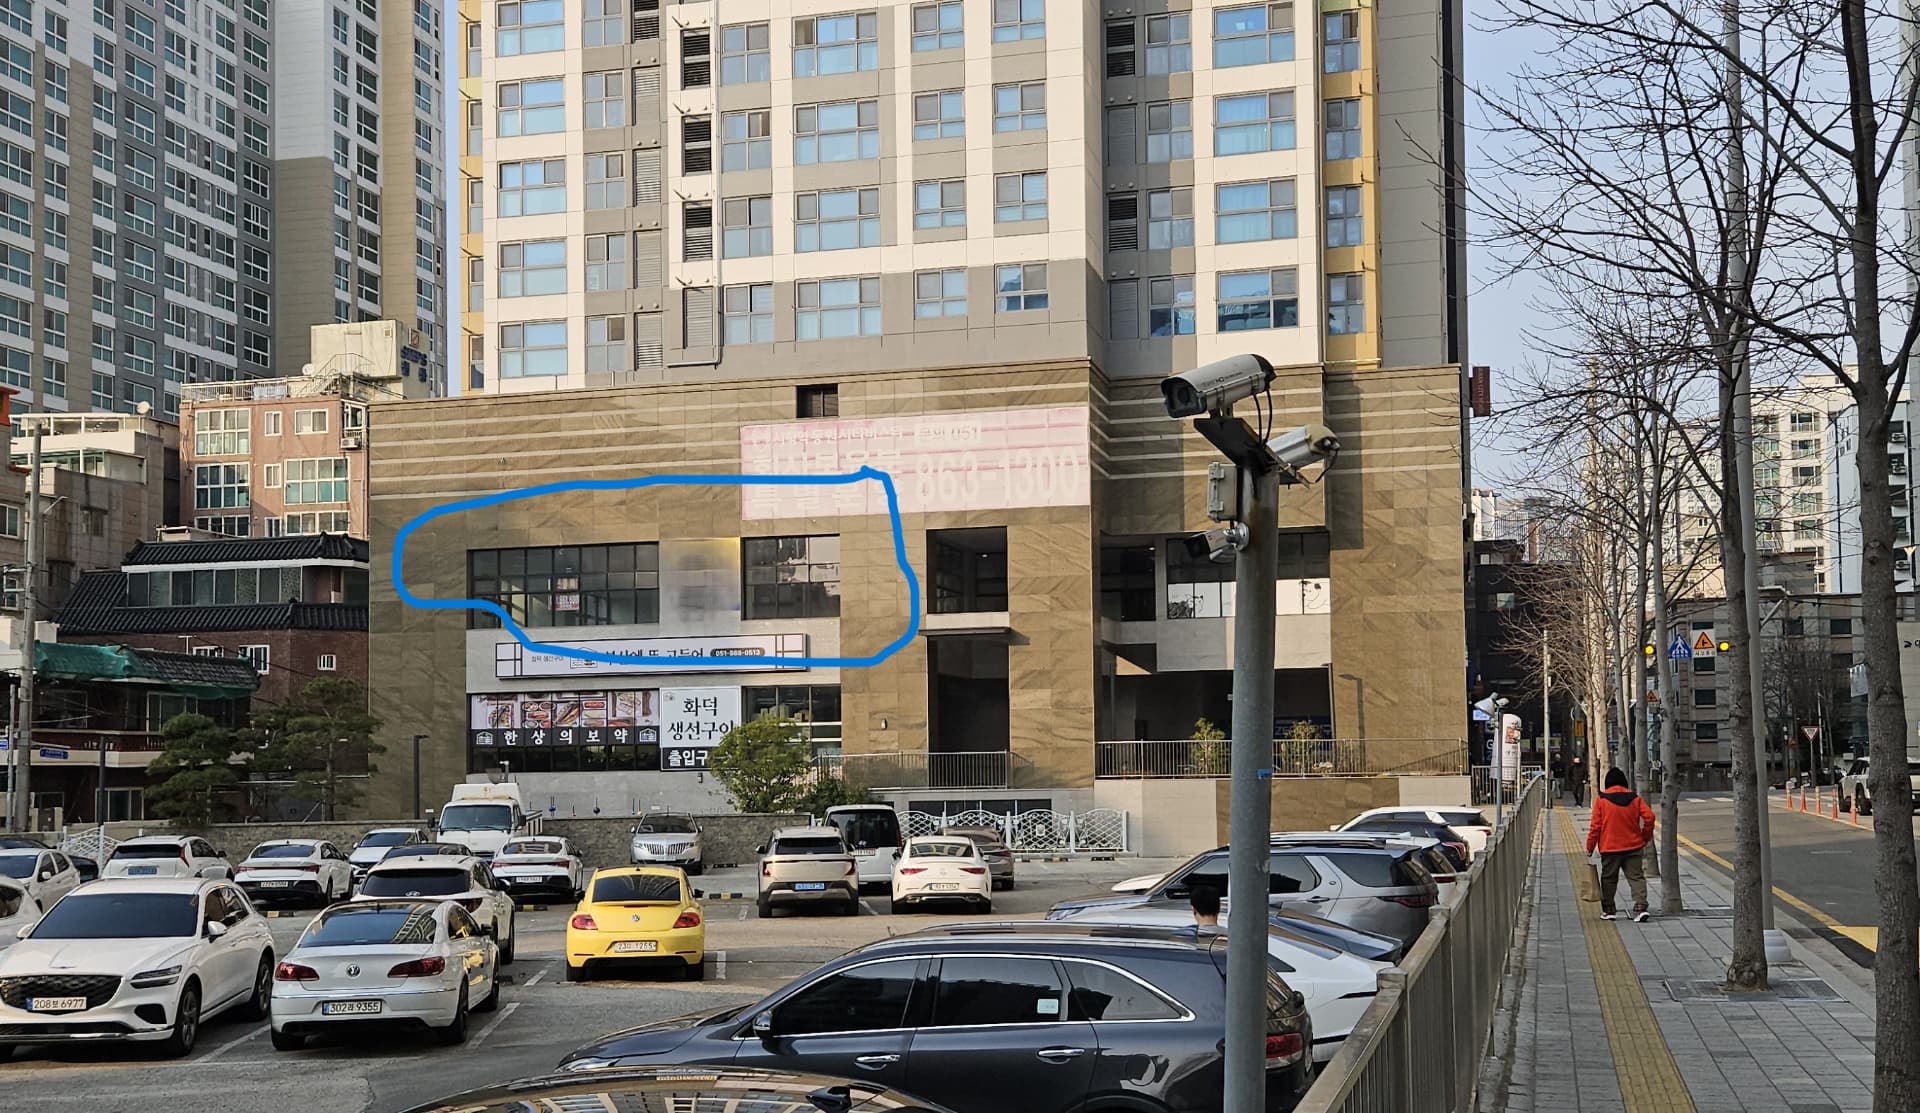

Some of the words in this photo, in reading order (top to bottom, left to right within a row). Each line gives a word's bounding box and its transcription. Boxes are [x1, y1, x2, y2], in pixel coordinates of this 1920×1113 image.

[682, 696, 718, 717] 화덕
[667, 720, 735, 740] 생선구이
[667, 749, 708, 767] 출입구
[60, 997, 85, 1008] 6977
[356, 1001, 379, 1012] 9355
